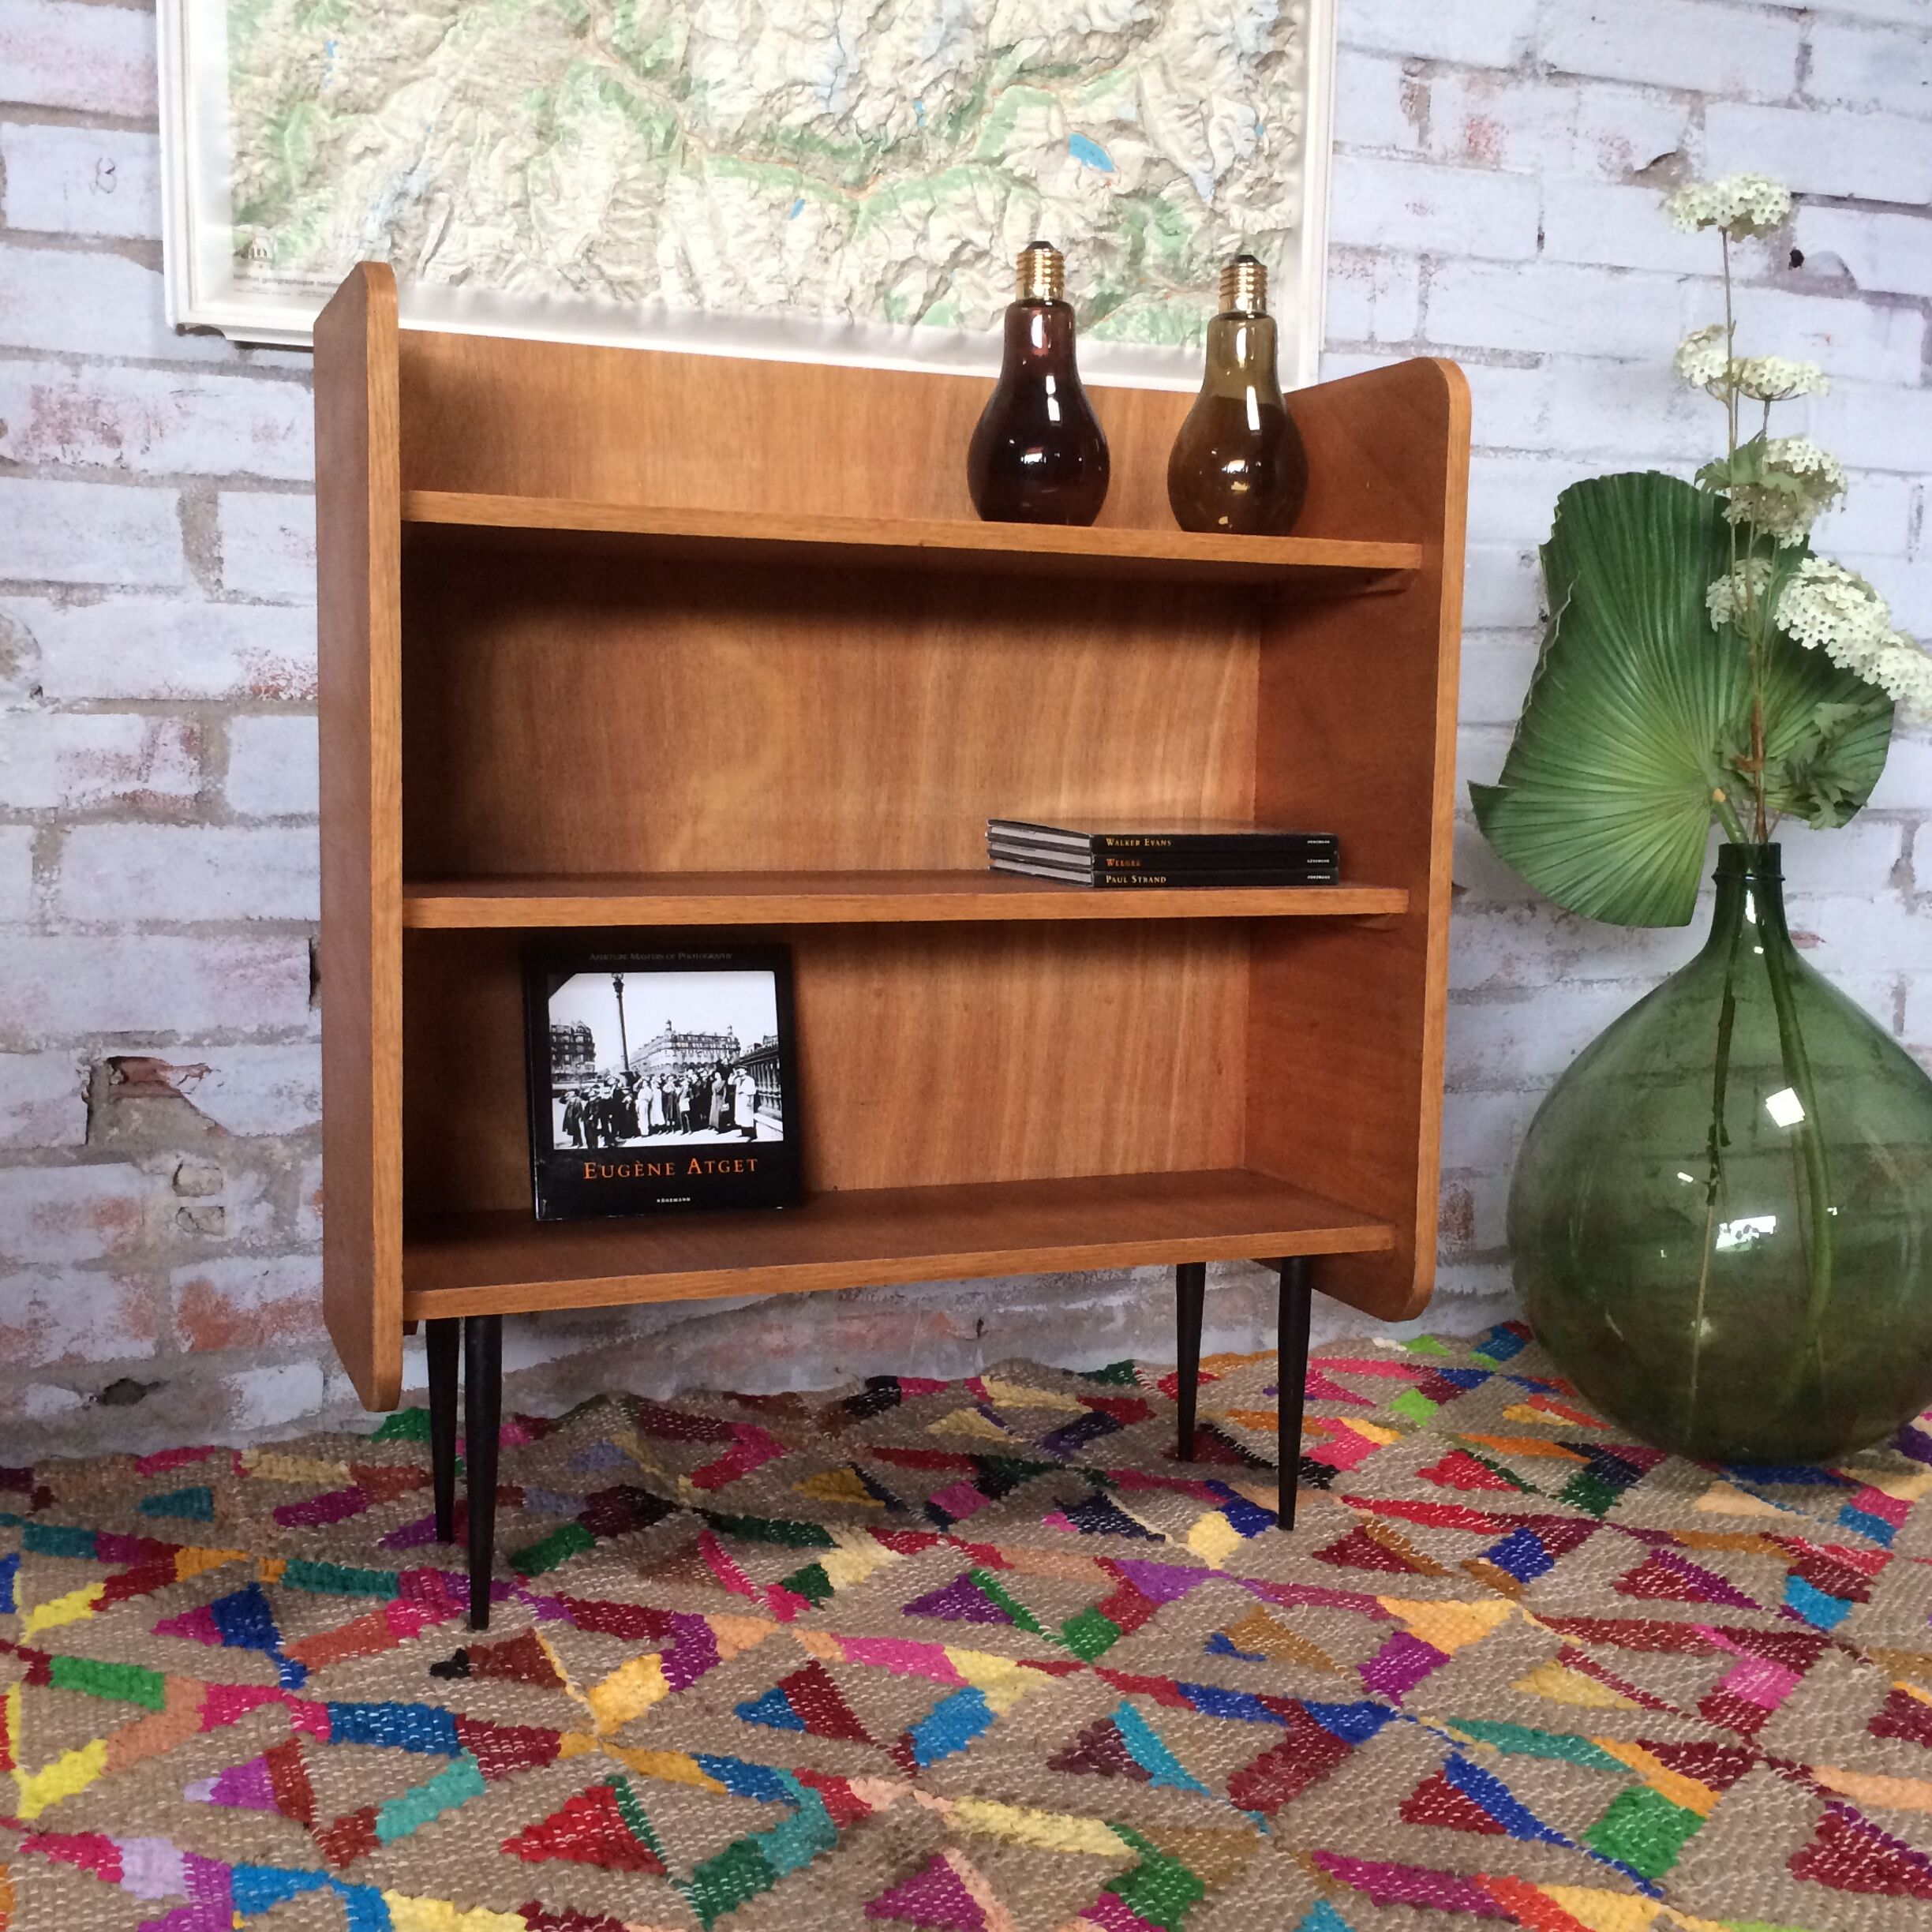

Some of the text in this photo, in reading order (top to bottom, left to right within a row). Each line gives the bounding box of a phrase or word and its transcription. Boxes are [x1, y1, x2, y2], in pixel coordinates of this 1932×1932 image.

[1106, 837, 1140, 846] WALKER
[1106, 874, 1166, 883] PAUL STRAND
[583, 1158, 758, 1179] EUGÈNE ATGET
